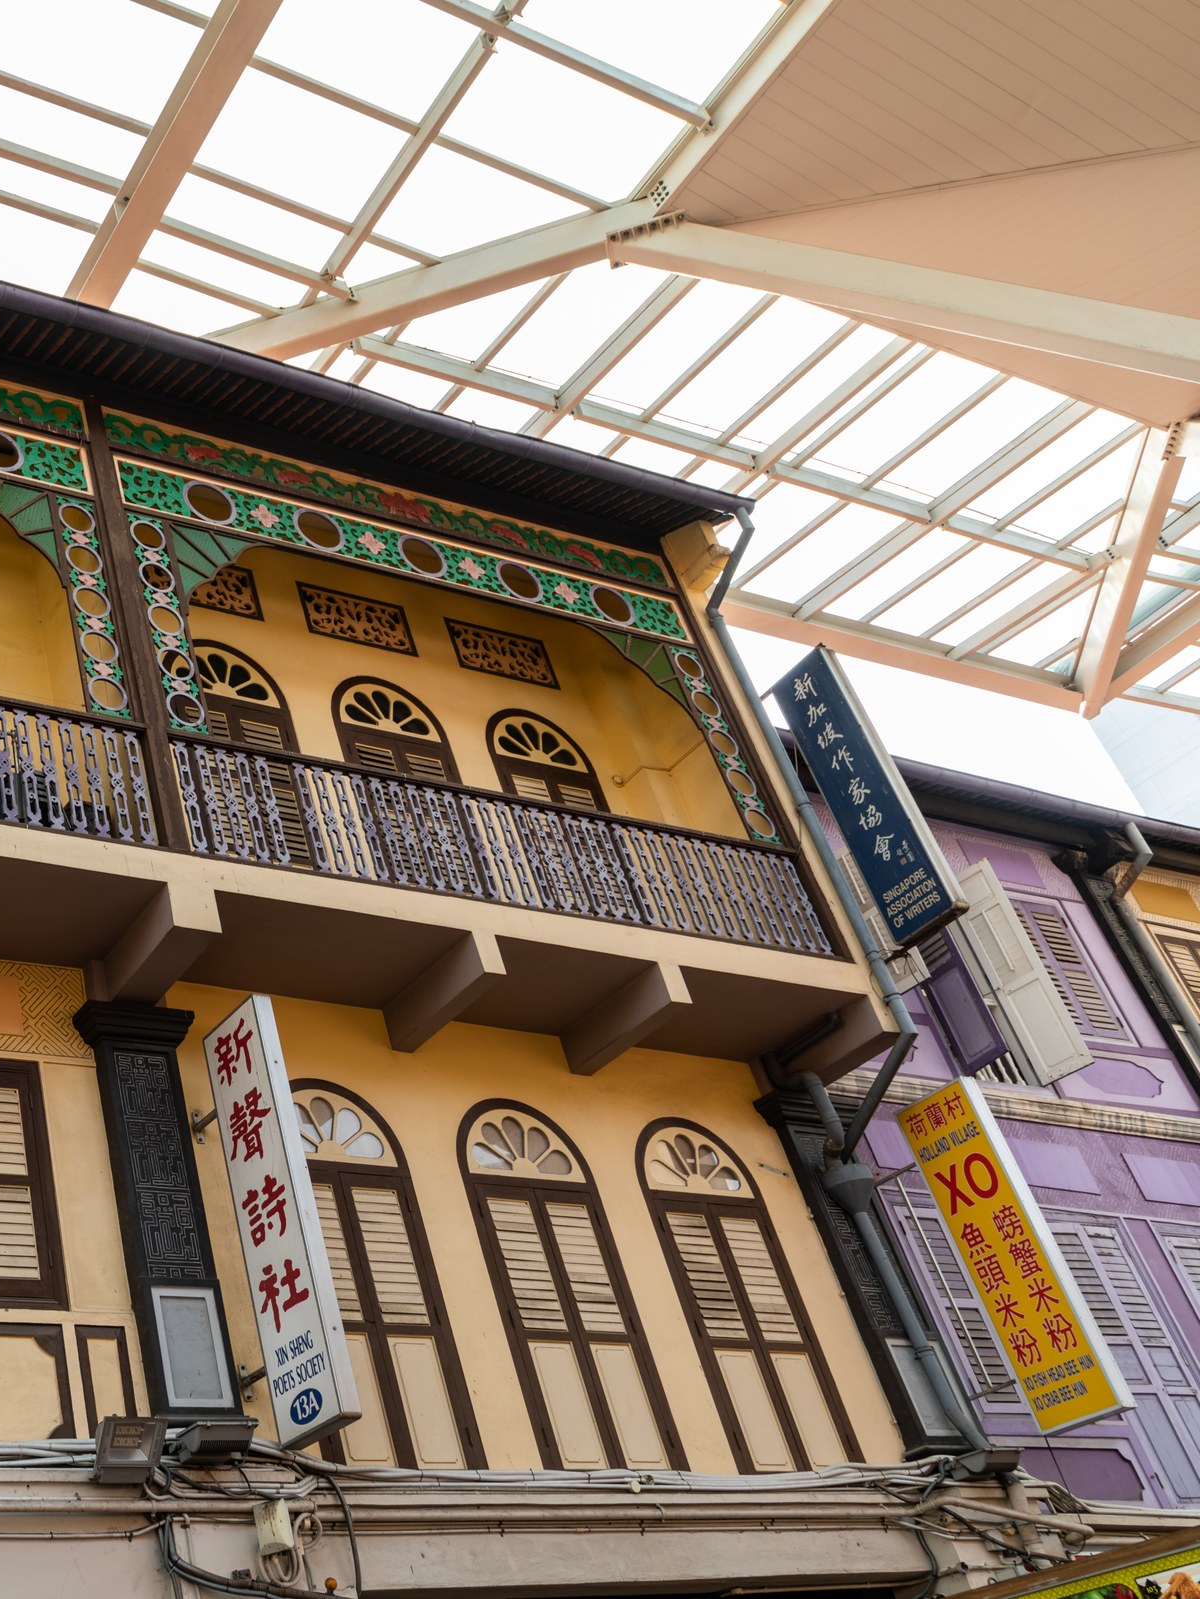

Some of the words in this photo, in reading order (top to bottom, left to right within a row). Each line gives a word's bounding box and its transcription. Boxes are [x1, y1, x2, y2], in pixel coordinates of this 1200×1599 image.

[793, 672, 895, 862] 新加坡作家協會
[883, 867, 927, 904] SINGAPORE
[886, 877, 937, 918] ASSOCIATION
[893, 914, 905, 928] OF
[904, 891, 941, 920] WRITERS
[906, 1091, 966, 1140] 荷蘭村
[918, 1136, 950, 1164] HOLLAND
[948, 1120, 980, 1147] VILLAGE
[214, 1017, 310, 1334] 新聲詩社
[933, 1152, 999, 1217] XO
[960, 1222, 1042, 1368] 魚頭米粉
[992, 1204, 1078, 1353] 螃蟹米粉
[275, 1345, 289, 1368] XIN
[288, 1330, 314, 1360] SHENG
[272, 1370, 296, 1398] POETS
[296, 1351, 326, 1385] SOCIETY
[1023, 1377, 1035, 1392] XO
[1032, 1371, 1049, 1388] FISH
[1046, 1365, 1066, 1383] HEAD
[1063, 1359, 1080, 1376] BEE
[1077, 1354, 1095, 1371] HUN
[293, 1391, 320, 1421] 13A
[1032, 1396, 1044, 1411] XO
[1042, 1390, 1061, 1408] CRAB
[1058, 1385, 1074, 1402] BEE
[1071, 1380, 1088, 1397] HUN
